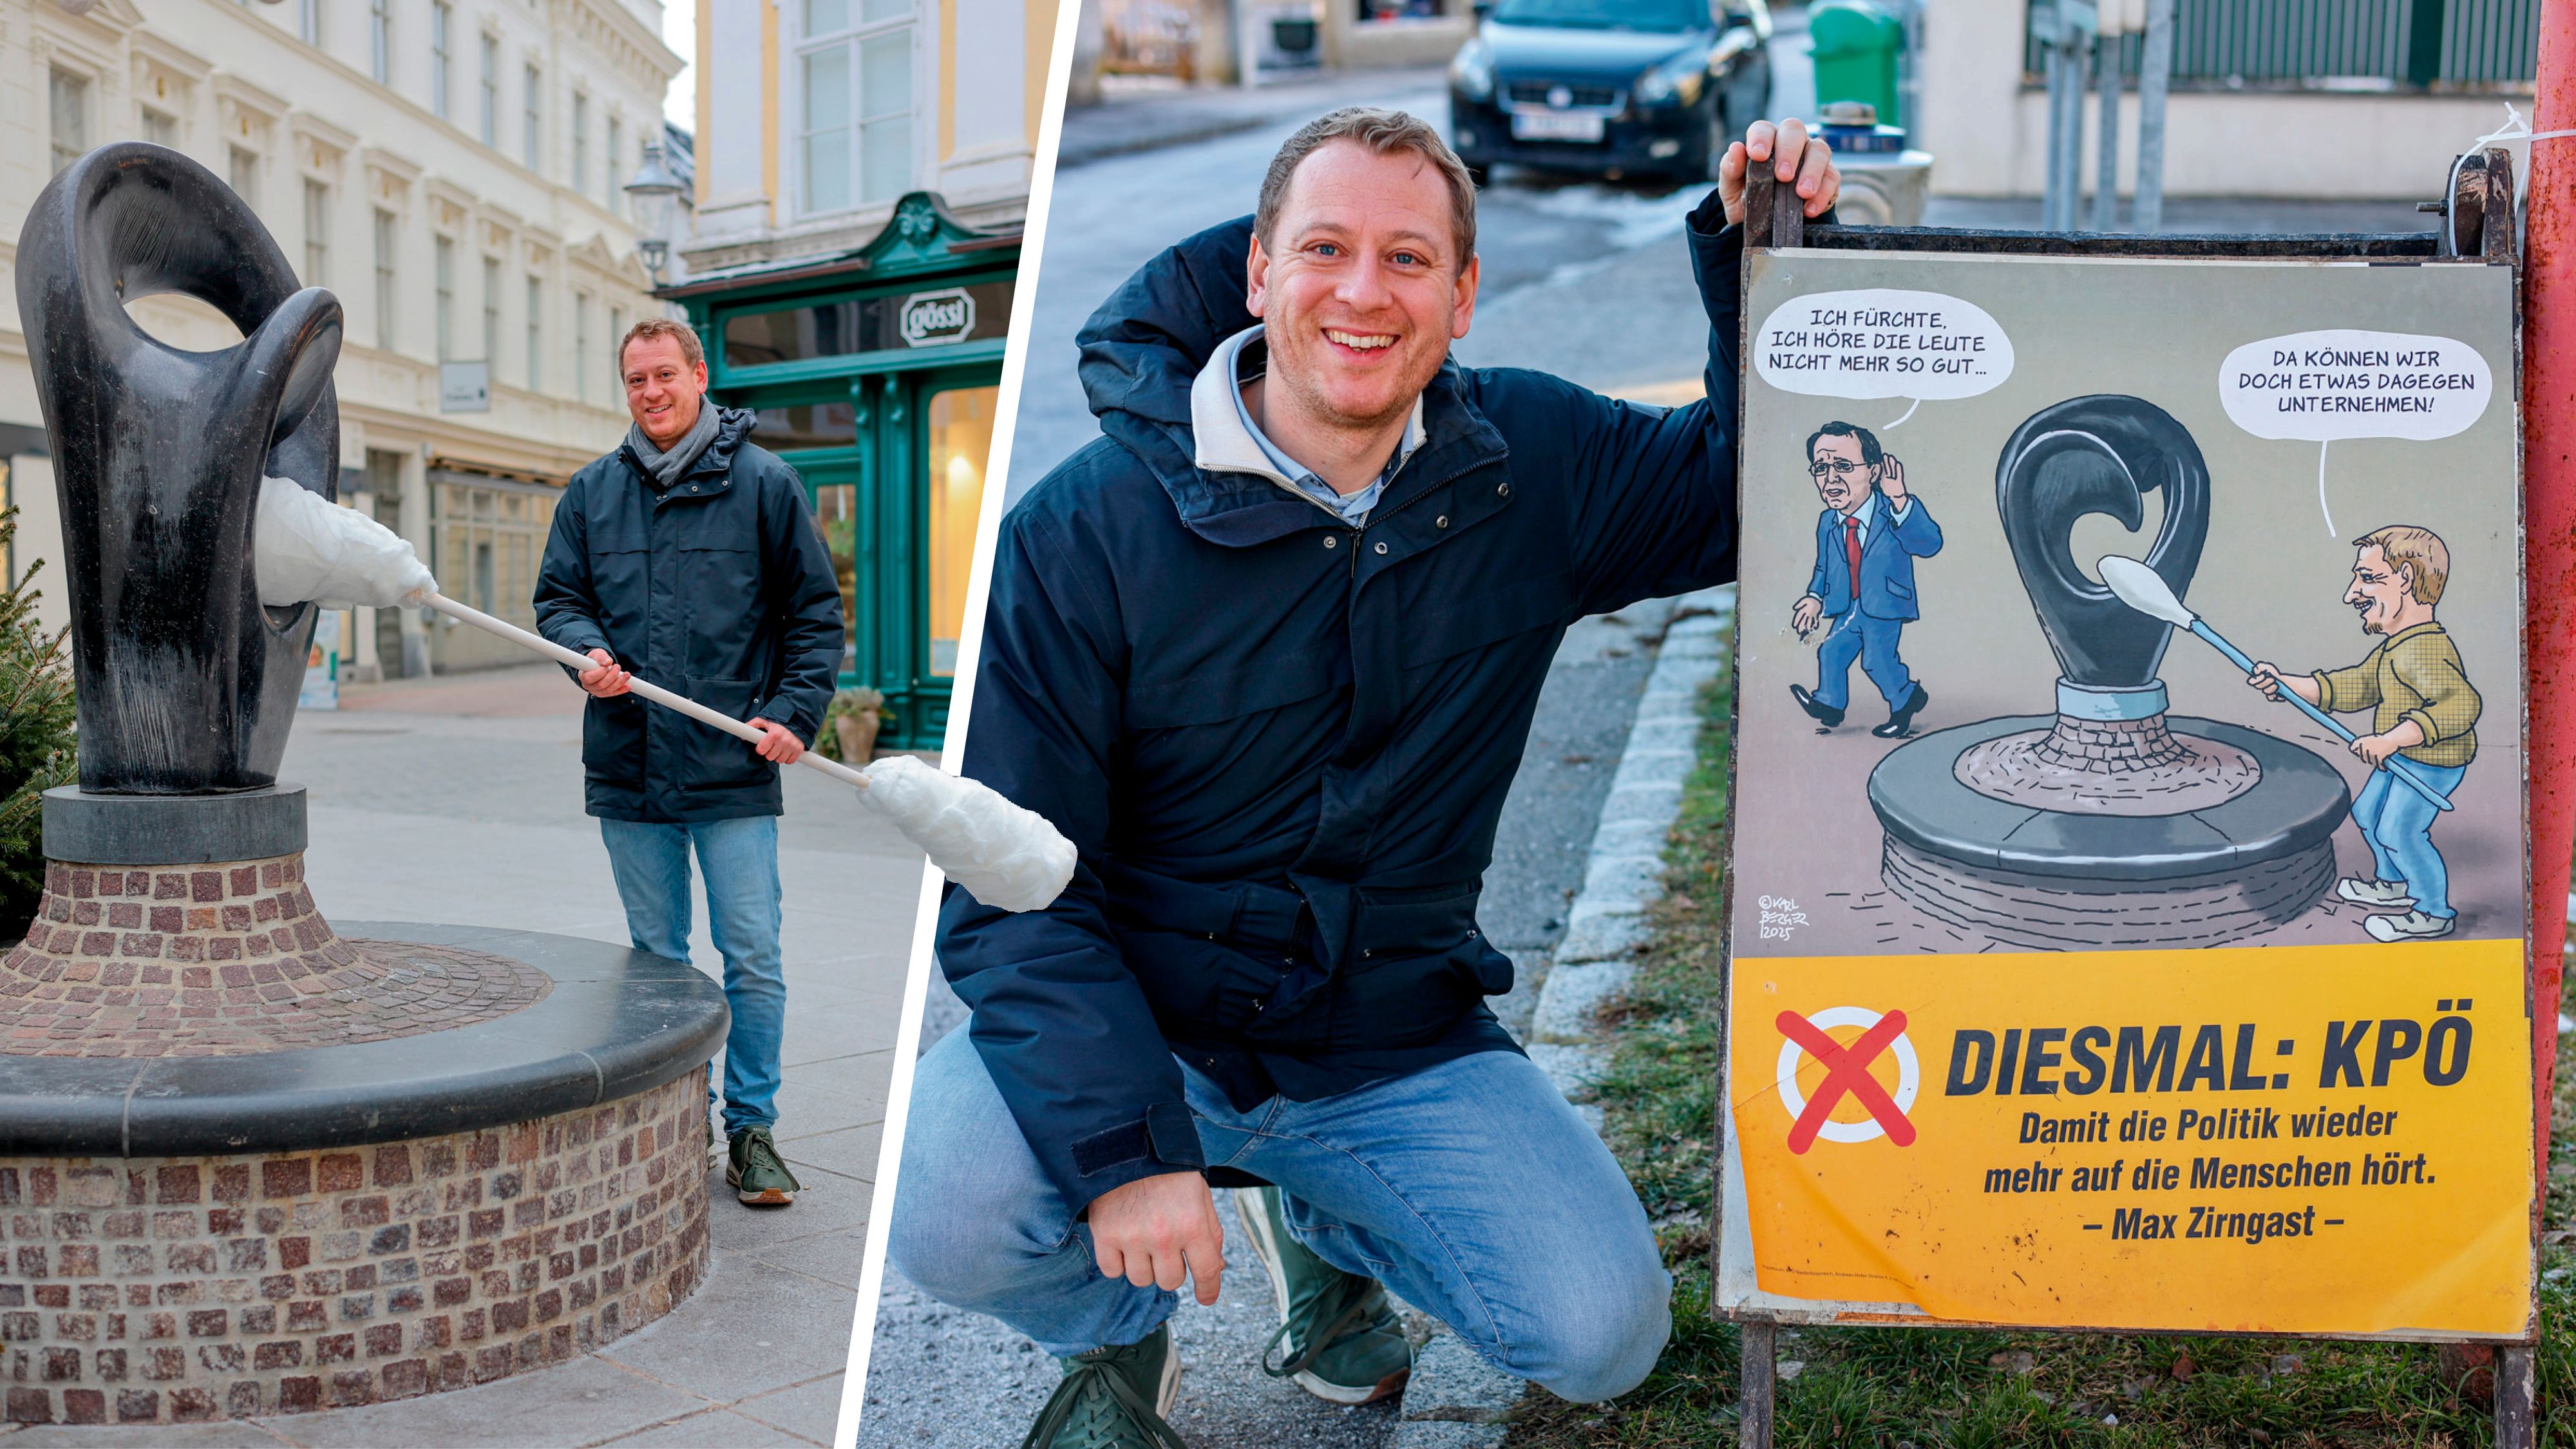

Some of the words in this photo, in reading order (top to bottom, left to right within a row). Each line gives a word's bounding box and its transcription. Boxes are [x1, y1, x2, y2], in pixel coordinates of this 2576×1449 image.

[909, 299, 966, 338] gössl
[1810, 310, 1846, 326] ICH
[1853, 307, 1947, 330] FÜRCHTE,
[1771, 331, 1808, 347] ICH
[1814, 328, 1866, 348] HÖRE
[1873, 334, 1911, 349] DIE
[1918, 334, 1985, 352] LEUTE
[1770, 353, 1832, 370] NICHT
[1839, 355, 1889, 372] MEHR
[1896, 356, 1924, 373] SO
[1931, 358, 1987, 375] GUT...
[2273, 350, 2297, 366] DA
[2305, 346, 2389, 366] KÖNNEN
[2396, 350, 2439, 366] WIR
[2239, 373, 2292, 390] DOCH
[2299, 374, 2370, 390] ETWAS
[2378, 374, 2474, 390] DAGEGEN
[2278, 396, 2434, 413] UNTERNEHMEN!
[1944, 1023, 2295, 1097] DIESMAL:
[2318, 998, 2473, 1088] KPÖ
[2019, 1111, 2110, 1144] Damit
[2119, 1110, 2167, 1142] die
[2177, 1107, 2281, 1141] Politik
[2291, 1104, 2398, 1138] wieder
[1984, 1160, 2063, 1193] mehr
[2071, 1159, 2124, 1192] auf
[2132, 1159, 2181, 1191] die
[2190, 1155, 2351, 1189] Menschen
[2361, 1151, 2436, 1186] hört.
[2112, 1207, 2179, 1240] Max
[2185, 1205, 2316, 1245] Zirngast
